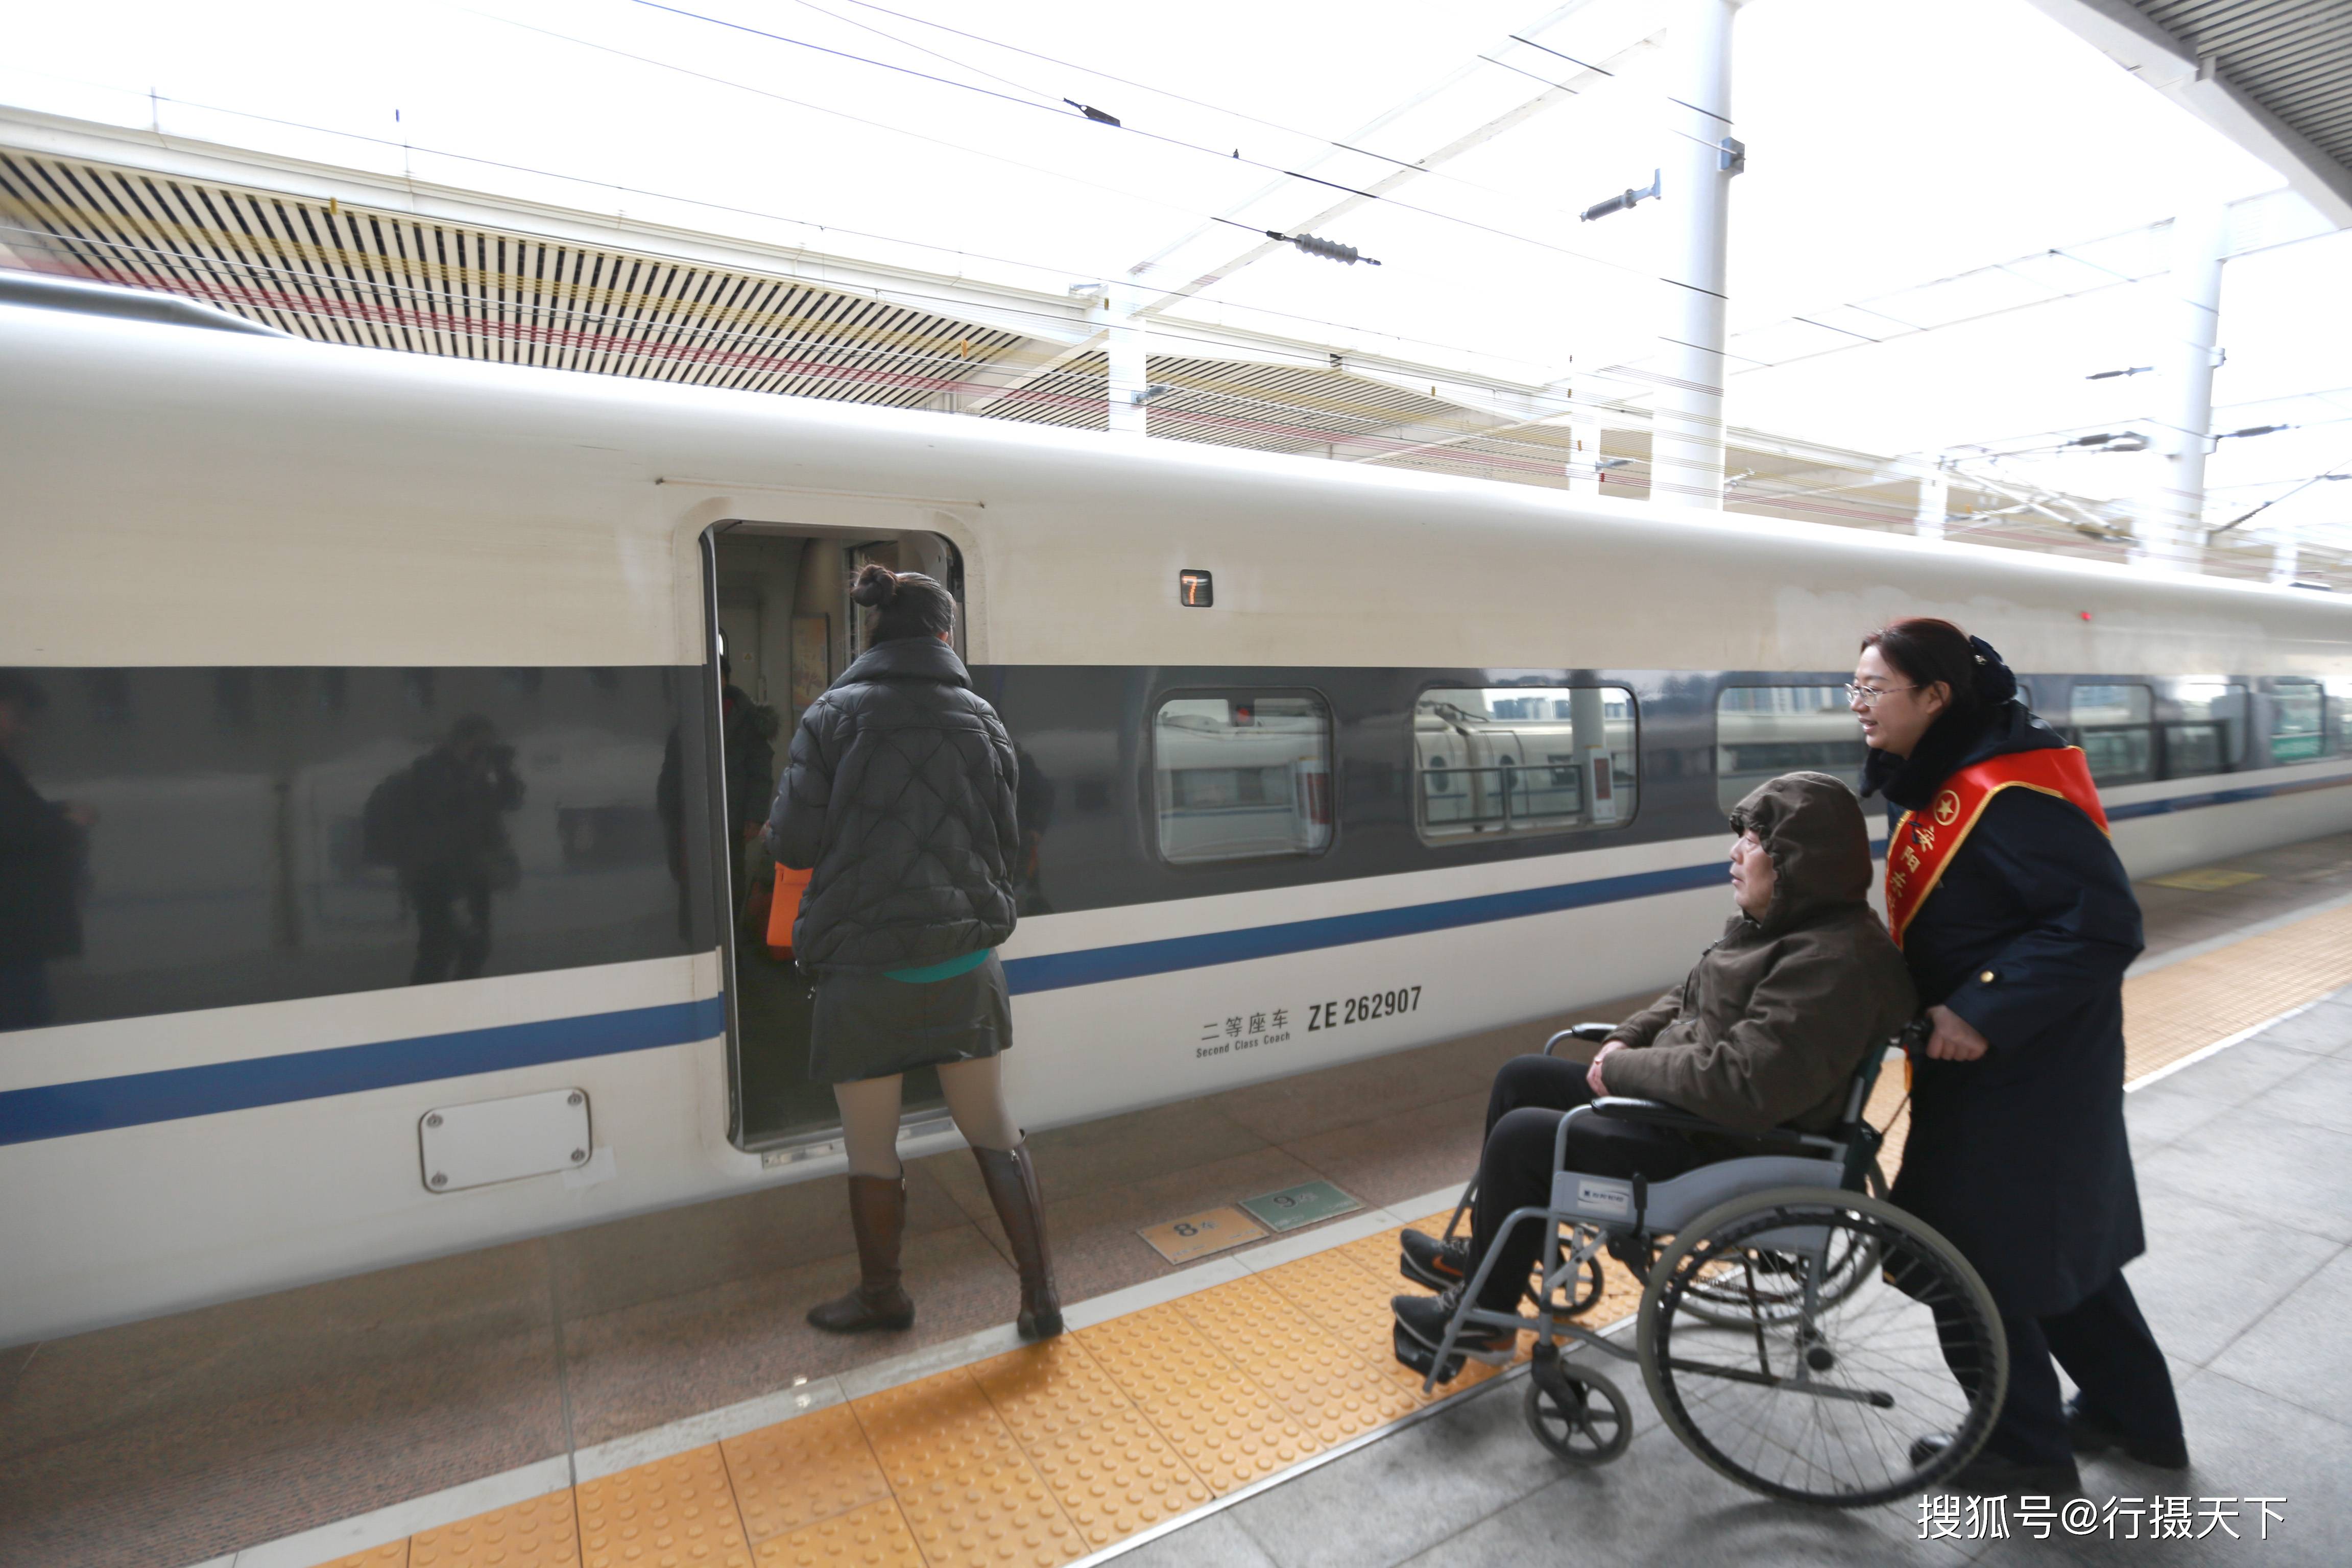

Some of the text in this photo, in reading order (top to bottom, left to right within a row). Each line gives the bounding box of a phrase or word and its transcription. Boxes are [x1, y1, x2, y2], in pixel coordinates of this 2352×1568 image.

[1182, 575, 1197, 605] 7
[1308, 986, 1422, 1032] ZE 262907
[1201, 1009, 1288, 1041] 二等座车
[1196, 1031, 1290, 1058] Second Class Coach
[1274, 1196, 1296, 1208] 9
[1173, 1223, 1198, 1237] 8
